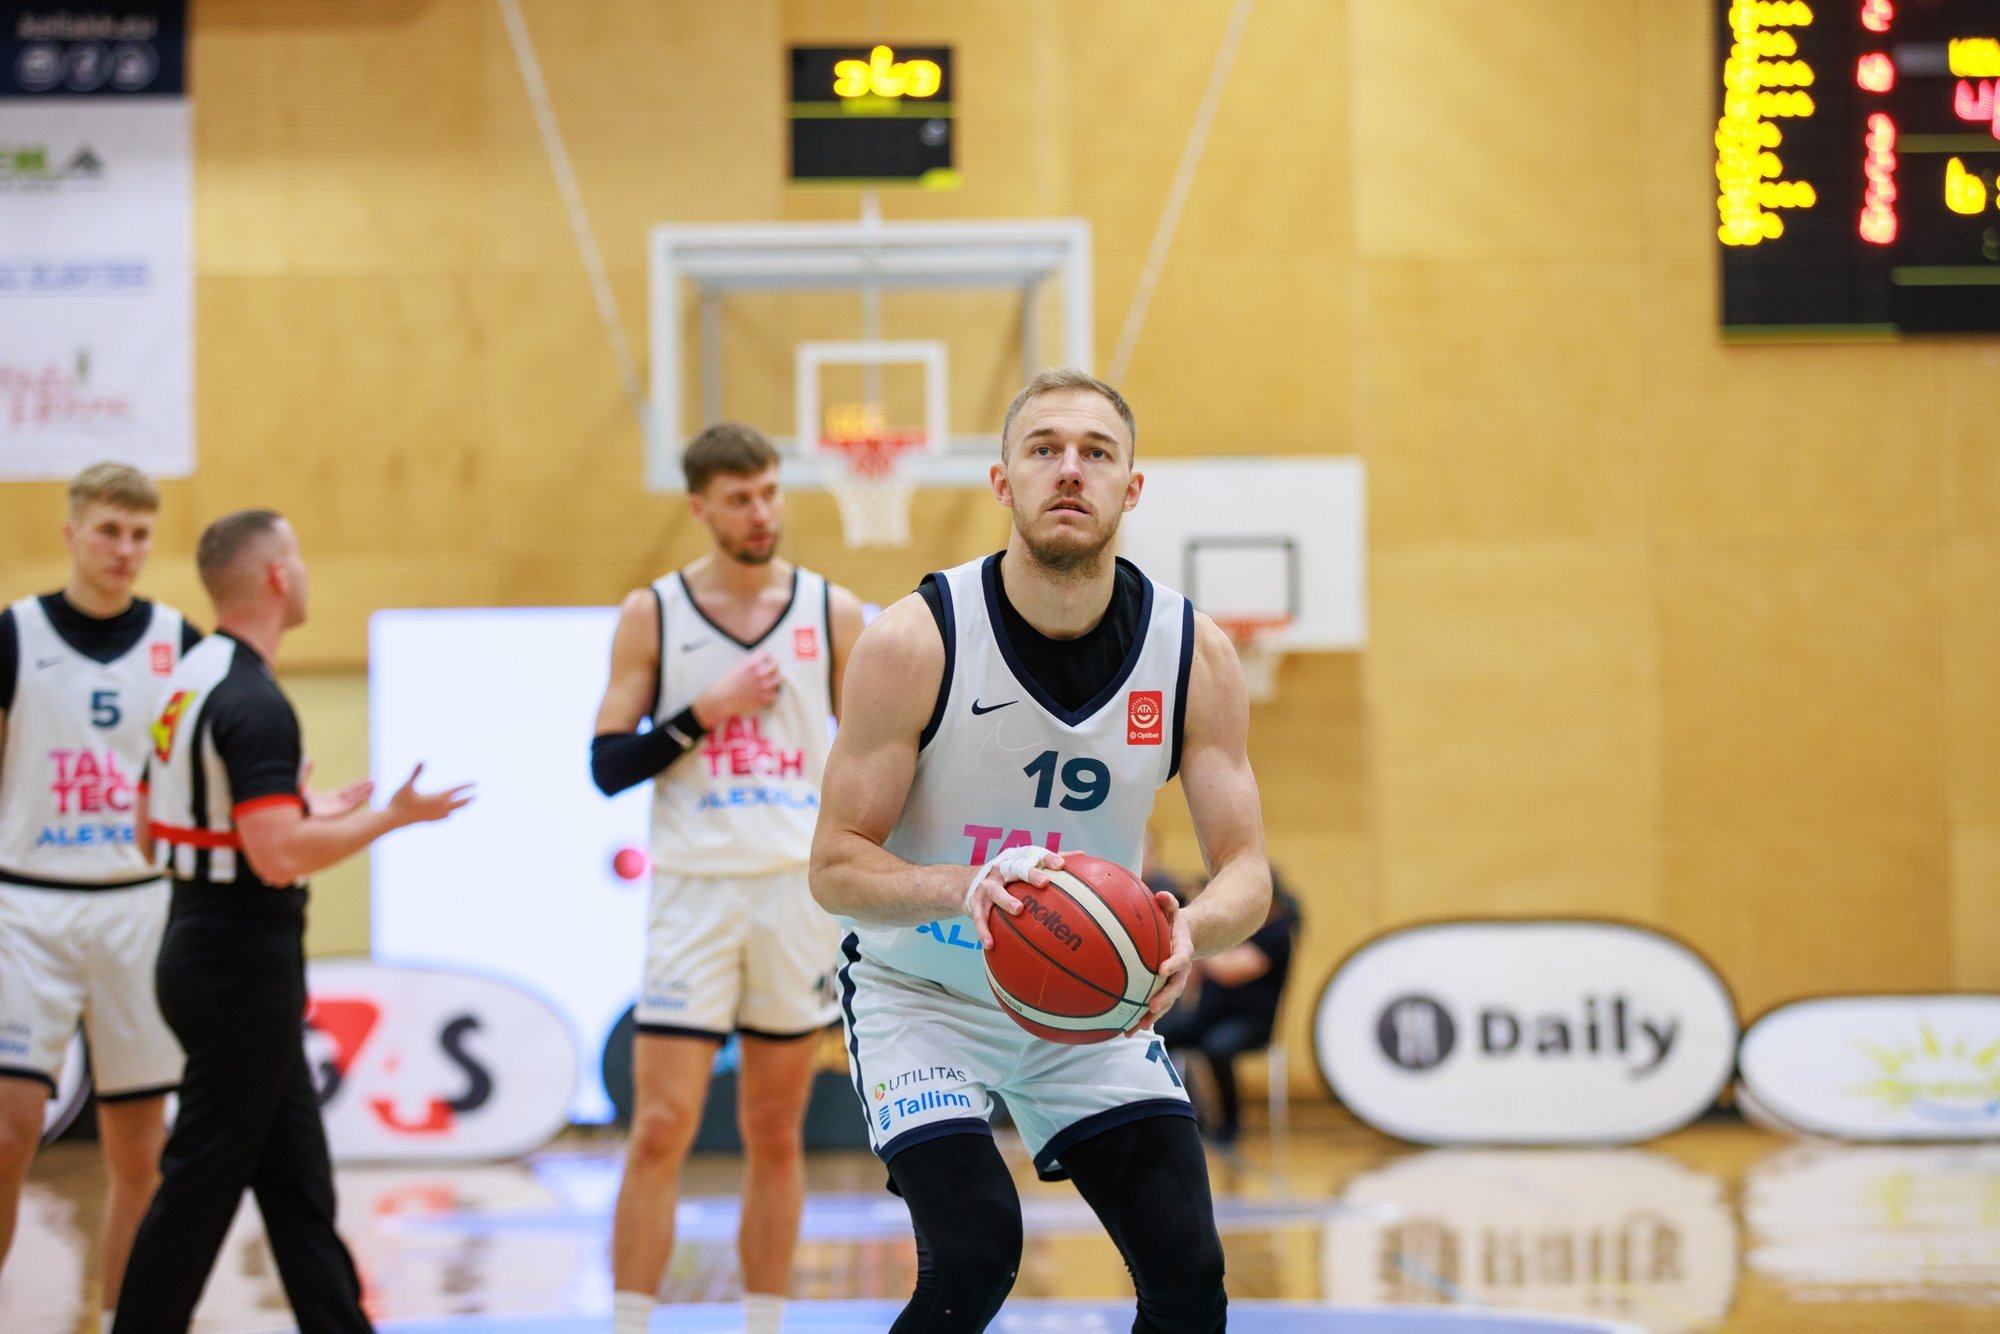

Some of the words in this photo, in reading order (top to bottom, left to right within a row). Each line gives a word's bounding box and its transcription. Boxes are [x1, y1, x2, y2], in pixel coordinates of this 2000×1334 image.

[89, 690, 122, 729] 5
[1137, 731, 1159, 739] Optibet
[48, 748, 124, 784] TAL
[702, 747, 805, 777] TECH
[50, 782, 132, 814] TEC
[1023, 750, 1111, 812] 19
[1019, 894, 1083, 952] molten
[1478, 996, 1680, 1079] Daily
[889, 1067, 967, 1091] UTILITAS
[894, 1090, 971, 1118] Tallinn
